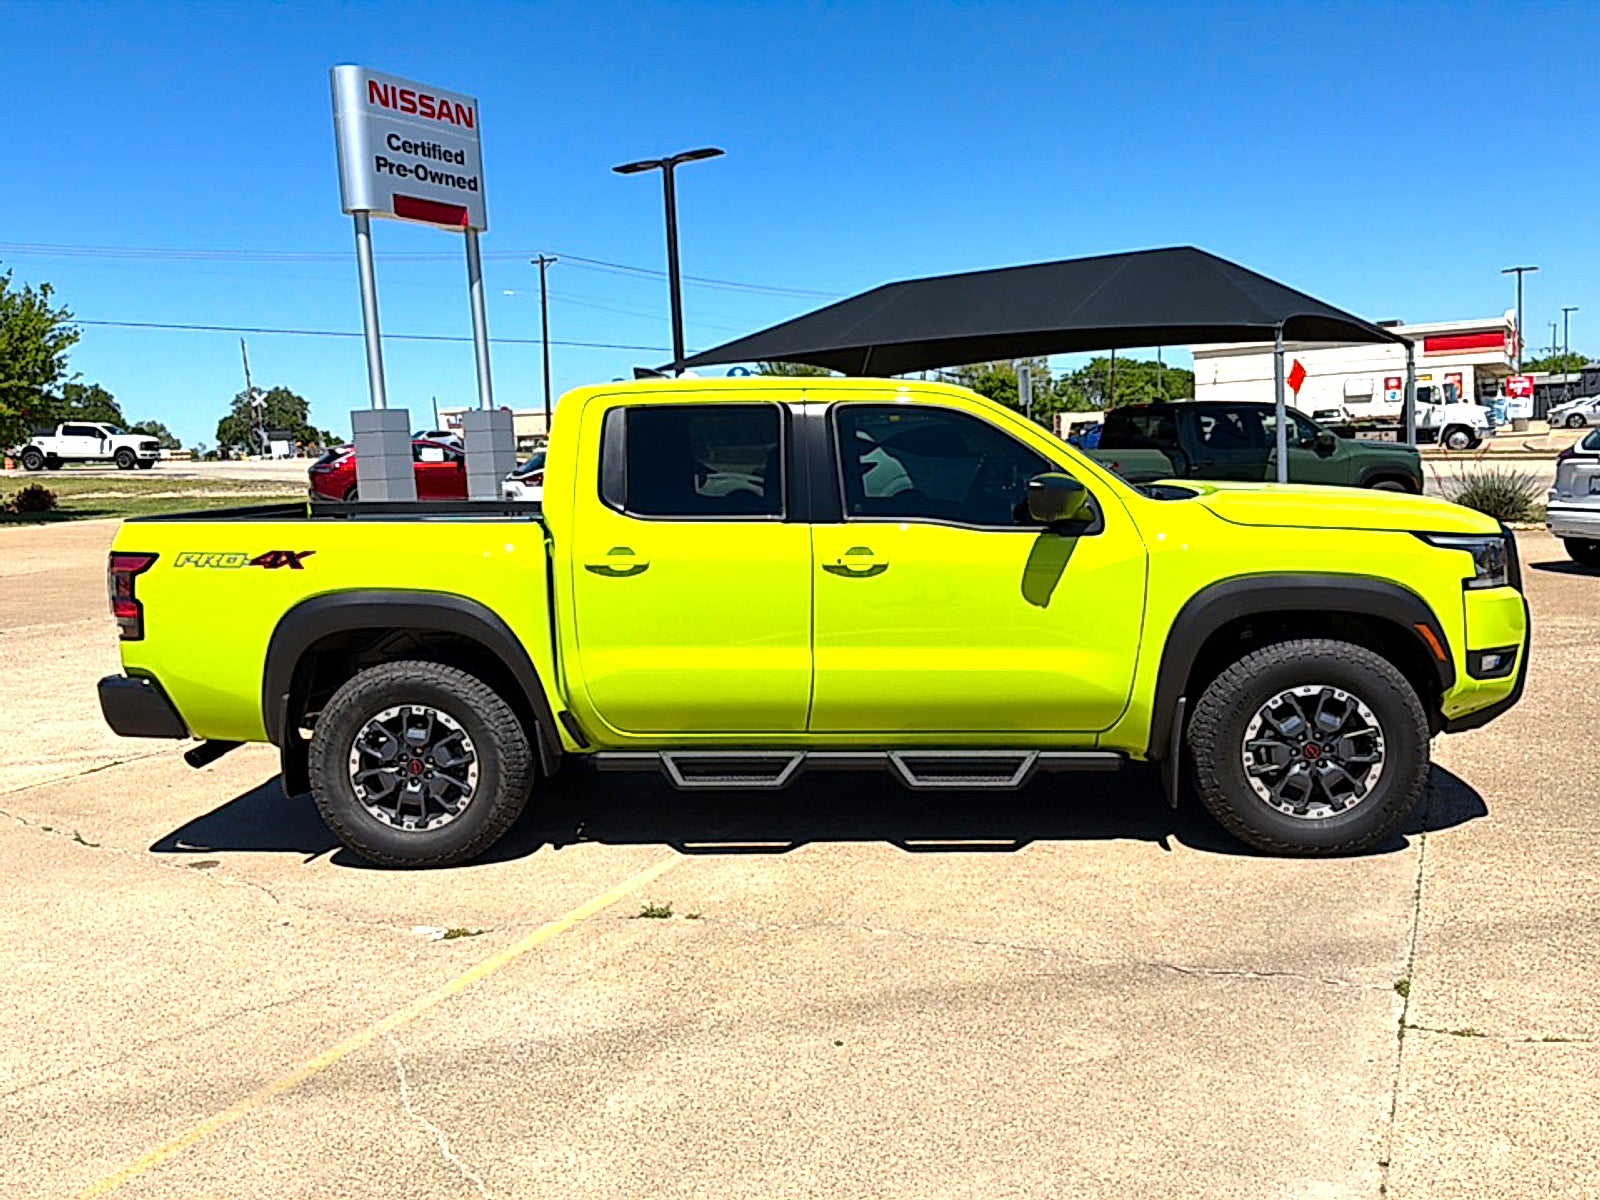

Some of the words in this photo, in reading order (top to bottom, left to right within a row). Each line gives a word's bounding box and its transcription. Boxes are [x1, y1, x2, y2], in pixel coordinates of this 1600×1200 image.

[368, 80, 474, 128] NISSAN
[386, 133, 465, 165] Certified
[375, 155, 478, 192] Pre-Owned
